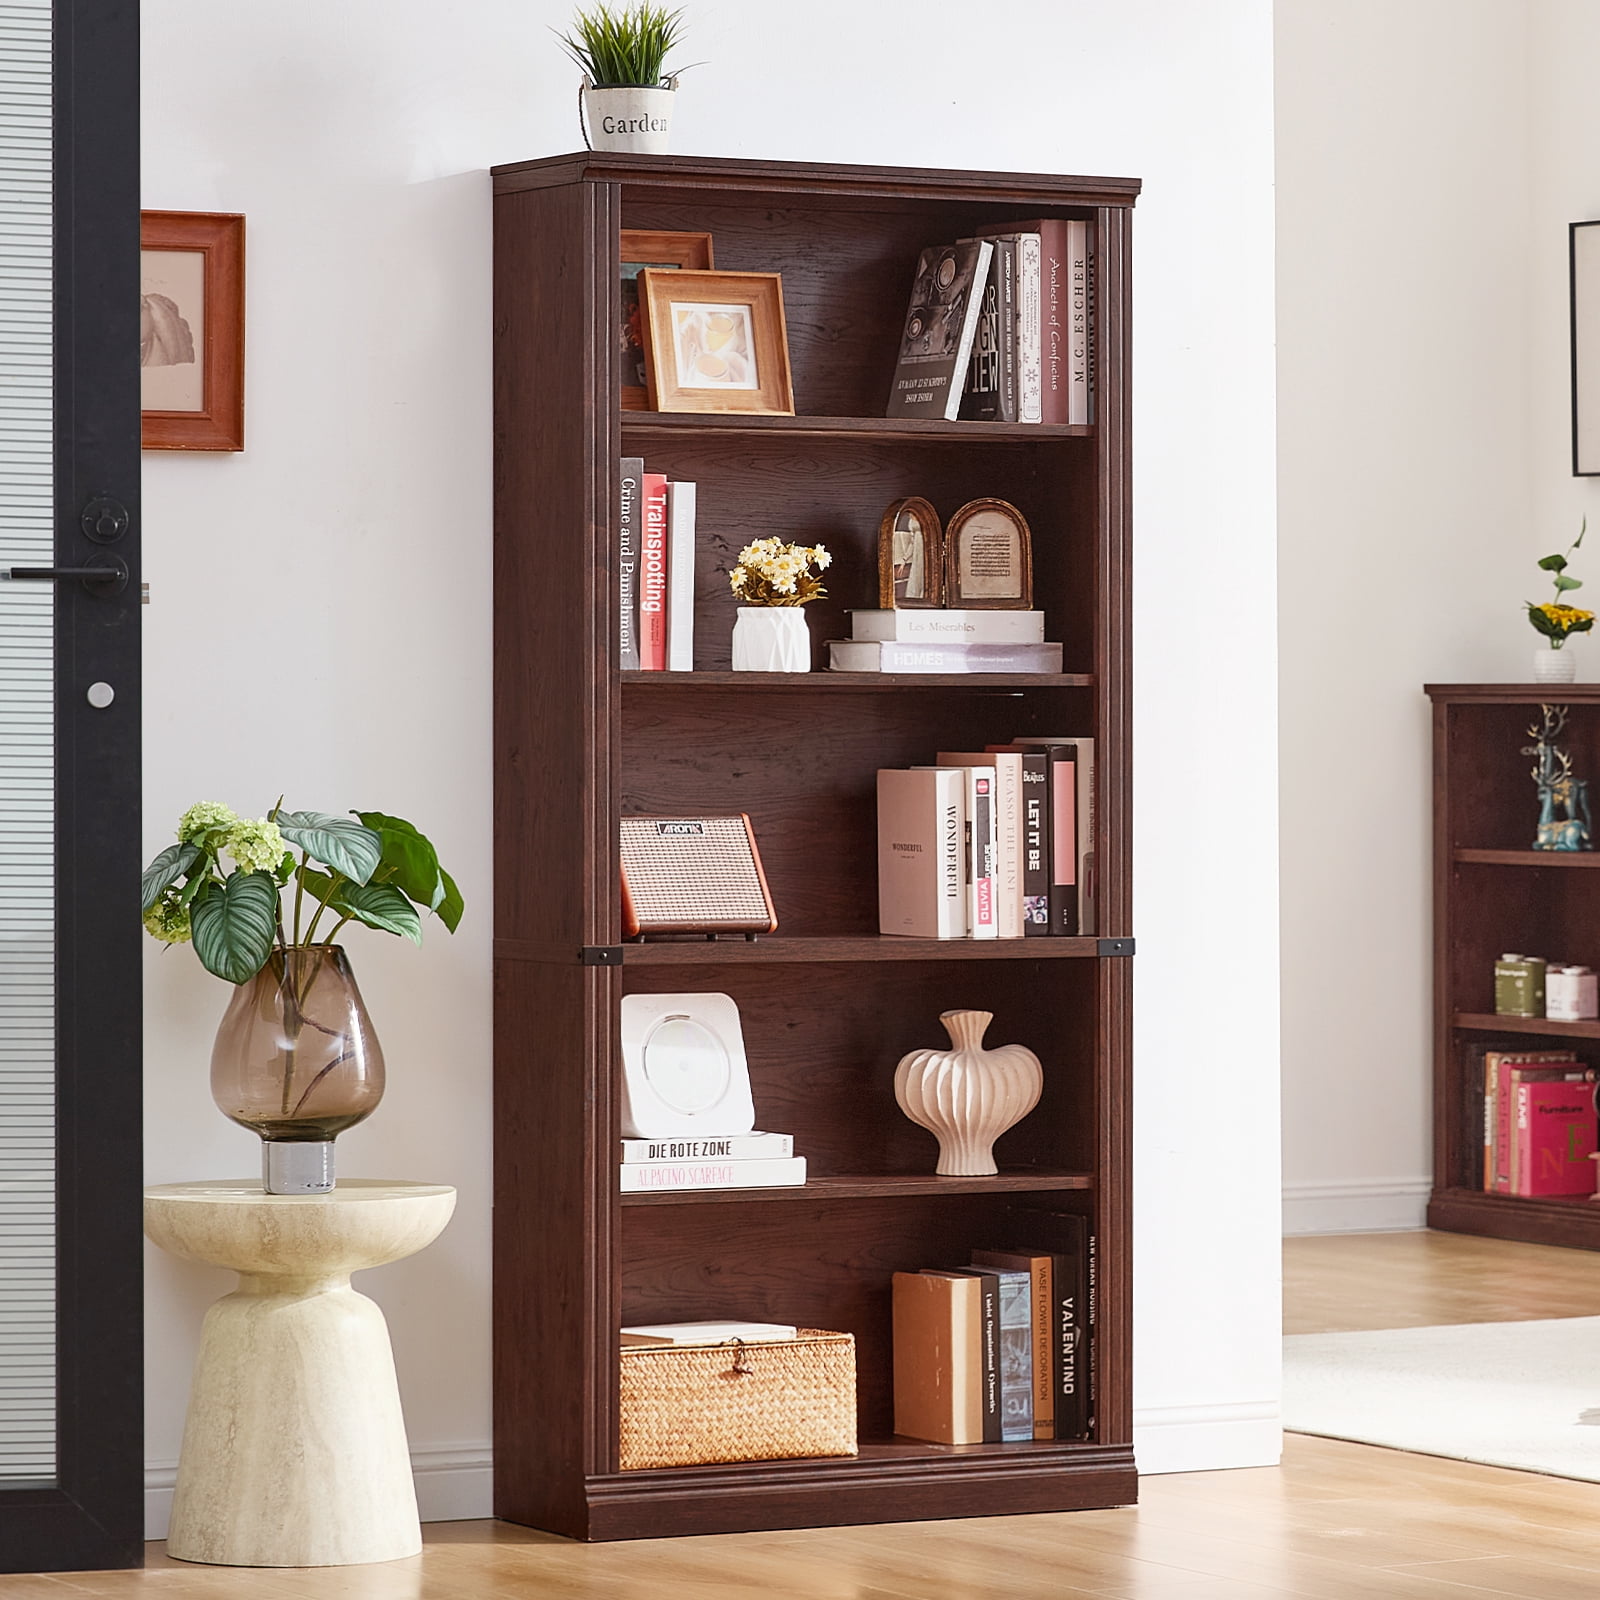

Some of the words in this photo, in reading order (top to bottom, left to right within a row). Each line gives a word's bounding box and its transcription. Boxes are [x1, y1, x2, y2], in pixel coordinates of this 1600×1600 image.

[602, 113, 667, 134] Garden
[1049, 257, 1061, 311] Analects
[1074, 259, 1084, 333] ESCHER
[1048, 315, 1061, 327] of
[1048, 331, 1061, 391] Confucius
[620, 477, 636, 524] Crime
[620, 527, 634, 556] and
[620, 559, 635, 655] Punishment
[909, 622, 924, 632] Les
[894, 652, 944, 666] HOMES
[1005, 765, 1015, 820] PICASSO
[1028, 799, 1040, 828] LET
[946, 805, 957, 900] WONDERFUL
[1007, 825, 1016, 853] THE
[1028, 832, 1040, 846] IT
[1028, 850, 1040, 871] BE
[1008, 860, 1016, 894] LINE
[980, 881, 989, 921] OLIVIA
[648, 1143, 667, 1158] DIE
[669, 1142, 698, 1157] ROTE
[701, 1140, 731, 1156] ZONE
[650, 1166, 685, 1185] PACINO
[688, 1165, 734, 1184] SCARFACE
[1038, 1266, 1047, 1292] VASE
[1039, 1294, 1047, 1335] FLOWER
[1061, 1297, 1075, 1395] VALENTINO
[1039, 1337, 1048, 1400] DECORATION
